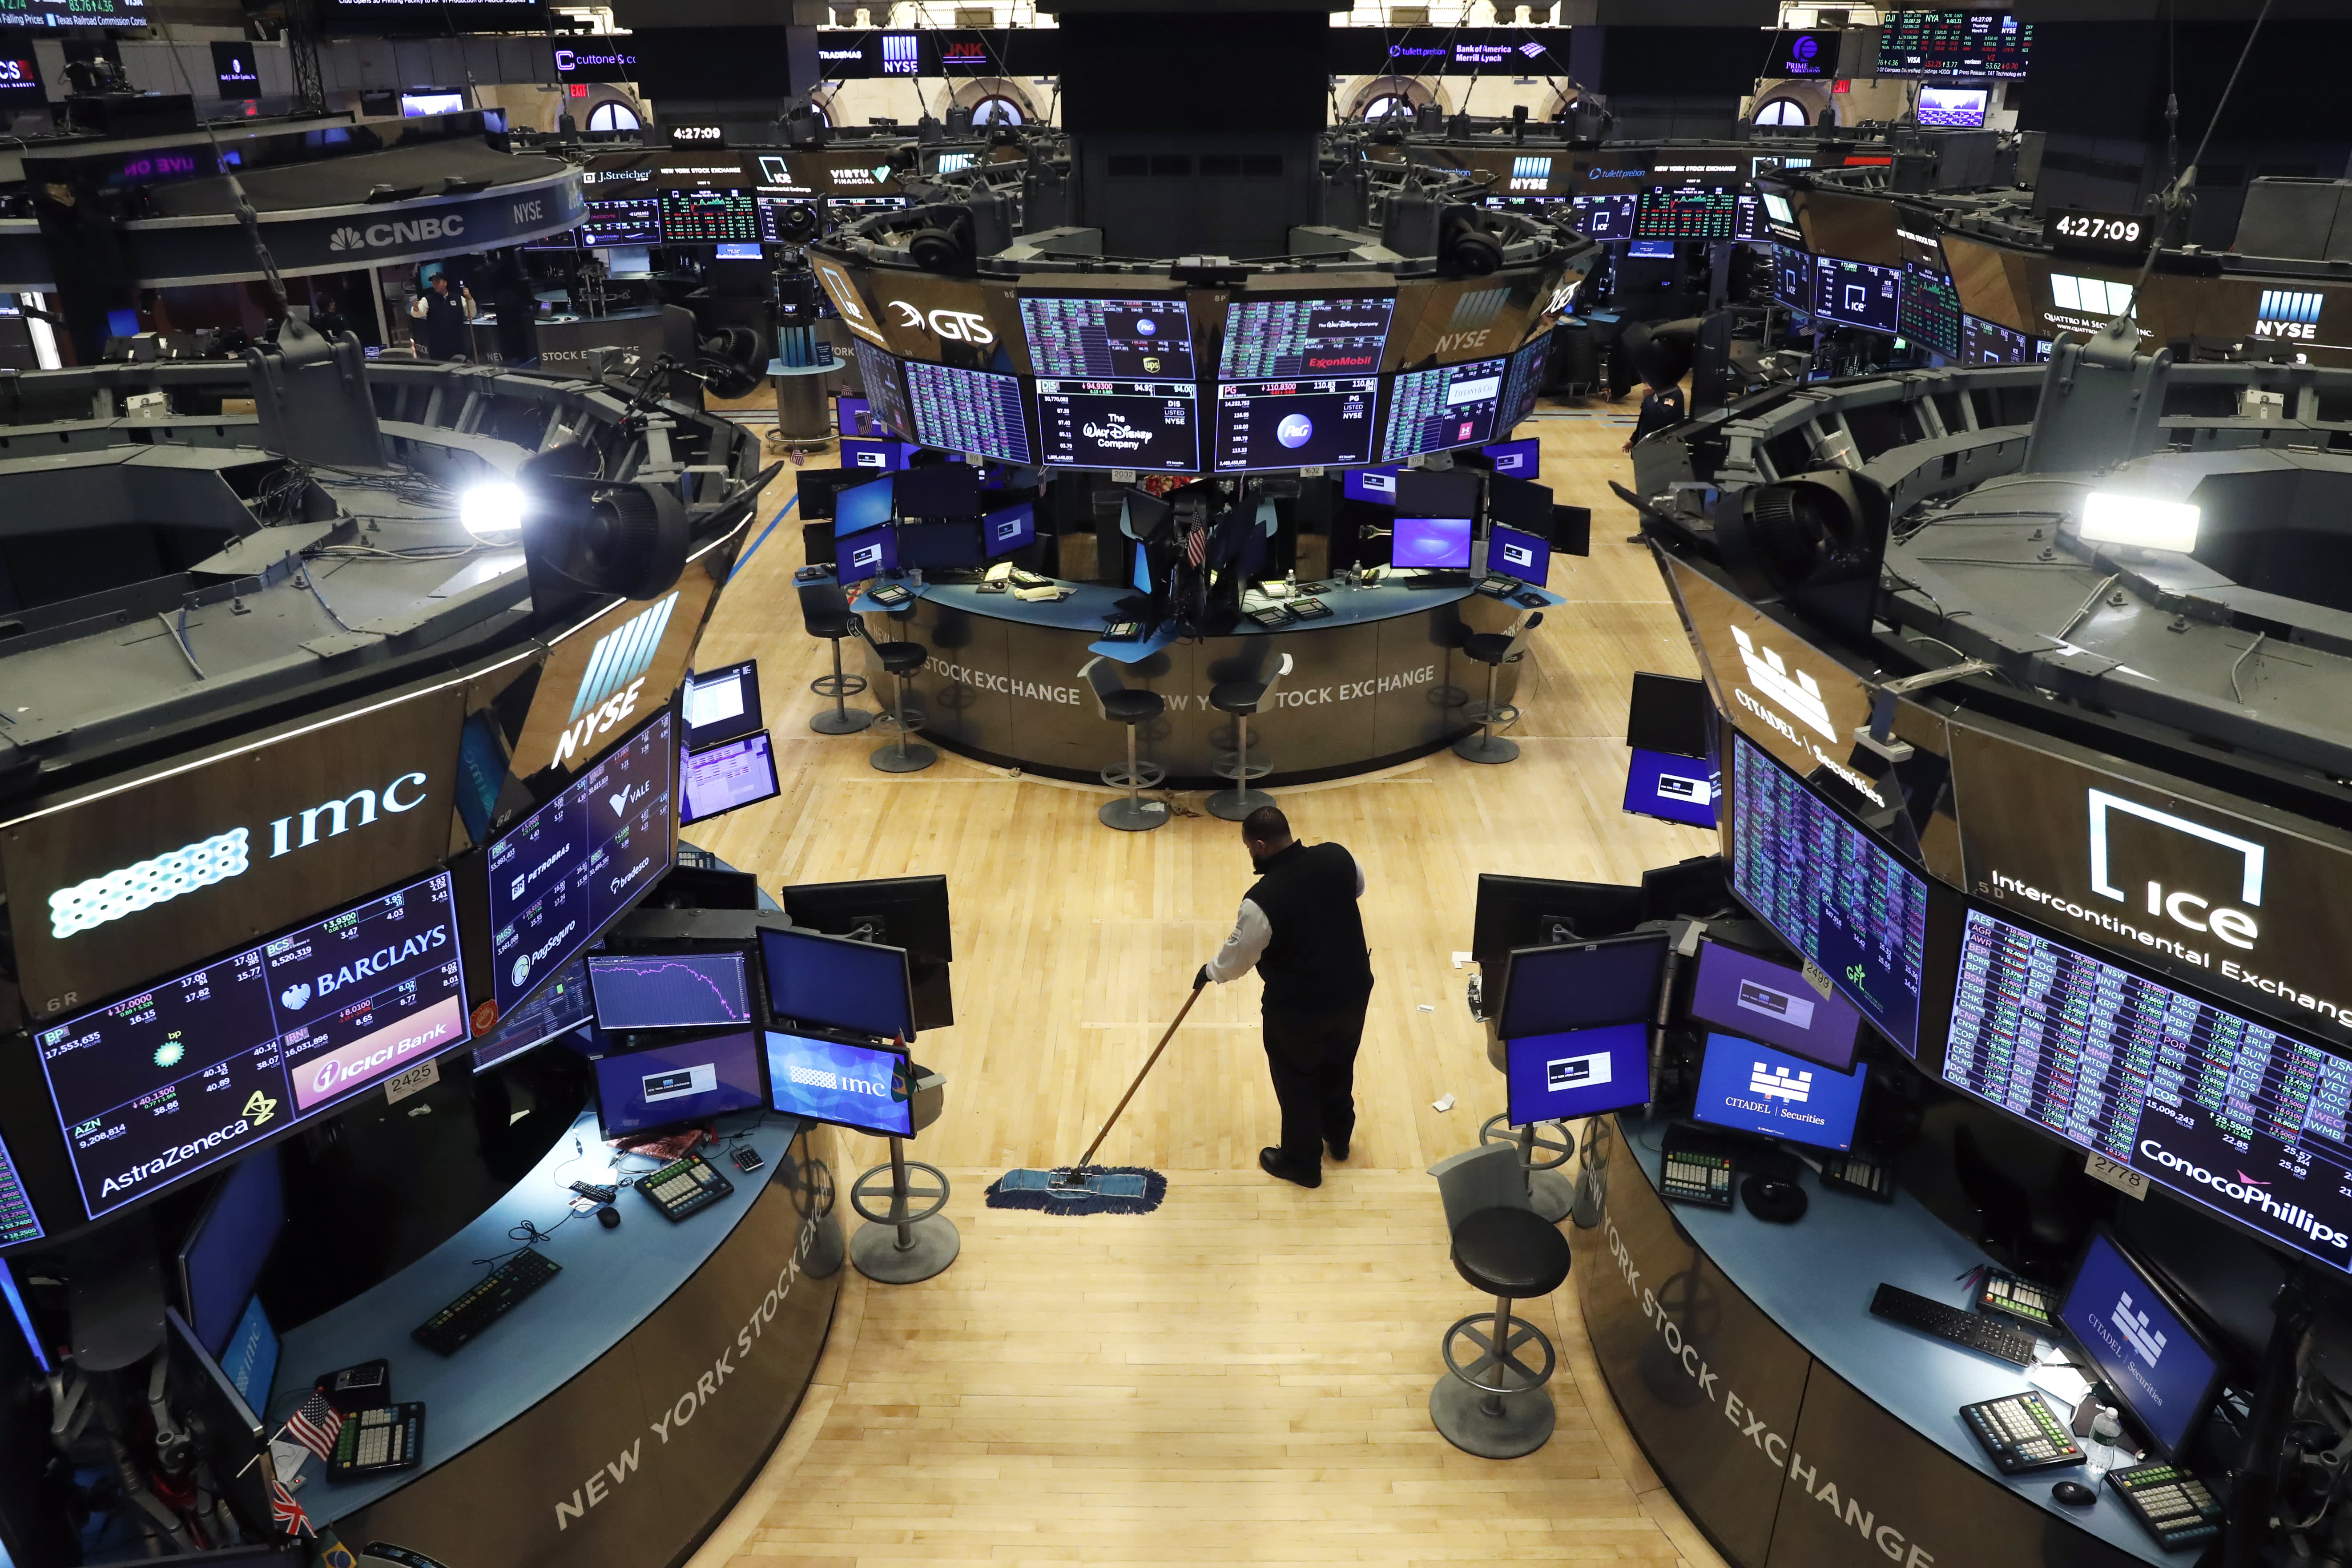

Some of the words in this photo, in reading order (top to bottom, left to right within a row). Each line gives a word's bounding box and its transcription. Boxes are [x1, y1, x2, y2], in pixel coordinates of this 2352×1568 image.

[2, 13, 24, 26] Falling
[25, 15, 44, 25] Prices
[56, 15, 73, 25] Texas
[74, 16, 97, 26] Railroad
[98, 17, 130, 26] Commission
[1925, 14, 1939, 22] NYA
[576, 55, 615, 64] cuttone
[618, 54, 624, 64] &
[944, 43, 984, 56] JNK
[1456, 45, 1474, 53] Bank
[1483, 45, 1511, 53] America
[1456, 54, 1479, 62] Merrill
[1481, 54, 1502, 63] Lynch
[884, 61, 918, 73] NYSE
[1785, 61, 1808, 69] PRIME
[570, 84, 587, 97] EXIT
[1832, 80, 1851, 93] EXIT
[673, 127, 721, 139] 4:27:09
[598, 170, 650, 183] J.Streicher
[830, 169, 870, 179] VIRTU
[1510, 178, 1548, 190] NYSE
[1602, 169, 1621, 177] tullett
[1622, 169, 1645, 179] prebon
[514, 200, 544, 225] NYSE
[365, 214, 465, 247] CNBC
[1897, 229, 1905, 238] NEW
[1905, 231, 1916, 241] YORK
[1916, 234, 1928, 244] STOCK
[2056, 216, 2140, 242] 4:27:09
[928, 309, 993, 344] GTS
[2044, 312, 2080, 325] QUATTRO
[2082, 318, 2090, 326] M
[2255, 320, 2317, 339] NYSE
[1434, 329, 1492, 355] NYSE
[1309, 356, 1372, 369] ExxonMobil
[1042, 381, 1056, 390] DIS
[1224, 386, 1236, 395] PG
[1267, 383, 1297, 391] 110.8300
[1108, 413, 1125, 423] The
[1284, 424, 1309, 438] P&G
[1097, 439, 1139, 451] Company
[1114, 470, 1133, 478] 2032
[923, 655, 971, 685] STOCK
[975, 670, 1081, 705] EXCHANGE
[1276, 685, 1332, 709] TOCK
[1339, 664, 1435, 701] EXCHANGE
[550, 676, 646, 771] NYSE
[1735, 688, 1802, 747] CITADEL
[1812, 745, 1886, 808] Securities
[629, 779, 650, 804] VALE
[492, 842, 505, 856] PBR
[528, 843, 570, 883] PETROBRAS
[620, 857, 649, 888] bradesco
[1972, 914, 1992, 927] AES
[1992, 870, 2209, 968] Intercontinental
[267, 938, 290, 955] BCS
[329, 911, 356, 929] 3.9300
[496, 926, 512, 944] PAGS
[532, 919, 576, 965] PagSeguro
[271, 946, 312, 967] 8,520,319
[316, 924, 447, 997] BARCLAYS
[1807, 962, 1829, 988] 2499
[2173, 996, 2196, 1010] OSG
[45, 1028, 64, 1044] BP
[114, 993, 153, 1015] 17.0000
[44, 1031, 101, 1060] 17,553,635
[129, 1009, 156, 1025] 16.15
[168, 1029, 182, 1040] bp
[2248, 1025, 2275, 1040] SMLP
[285, 1033, 329, 1058] 16,031,896
[340, 1045, 394, 1081] ICICI
[397, 1023, 447, 1055] Bank
[2163, 1036, 2186, 1052] POR
[391, 1064, 431, 1092] 2425
[2153, 1088, 2178, 1102] COP
[74, 1117, 102, 1136] AZN
[139, 1086, 175, 1106] 40.1300
[1725, 1096, 1771, 1114] CITADEL
[1780, 1108, 1825, 1125] Securities
[2146, 1099, 2195, 1126] 15,009,243
[2215, 1114, 2253, 1136] 25.5900
[80, 1123, 126, 1149] 9,208,814
[153, 1100, 179, 1117] 38.86
[101, 1119, 249, 1198] AstraZeneca
[2222, 1134, 2248, 1150] 22.85
[2278, 1159, 2307, 1176] 25.99
[2094, 1157, 2140, 1187] 2778
[2140, 1140, 2349, 1248] ConocoPhillips
[2088, 1312, 2122, 1359] CITADEL
[2127, 1360, 2163, 1407] Securities
[554, 1436, 641, 1532] NEW
[651, 1347, 735, 1445] YORK
[738, 1246, 801, 1359] STOCK
[1604, 1205, 1641, 1298] YORK
[1642, 1288, 1719, 1403] STOCK
[1724, 1390, 1935, 1568] EXCHANGE
